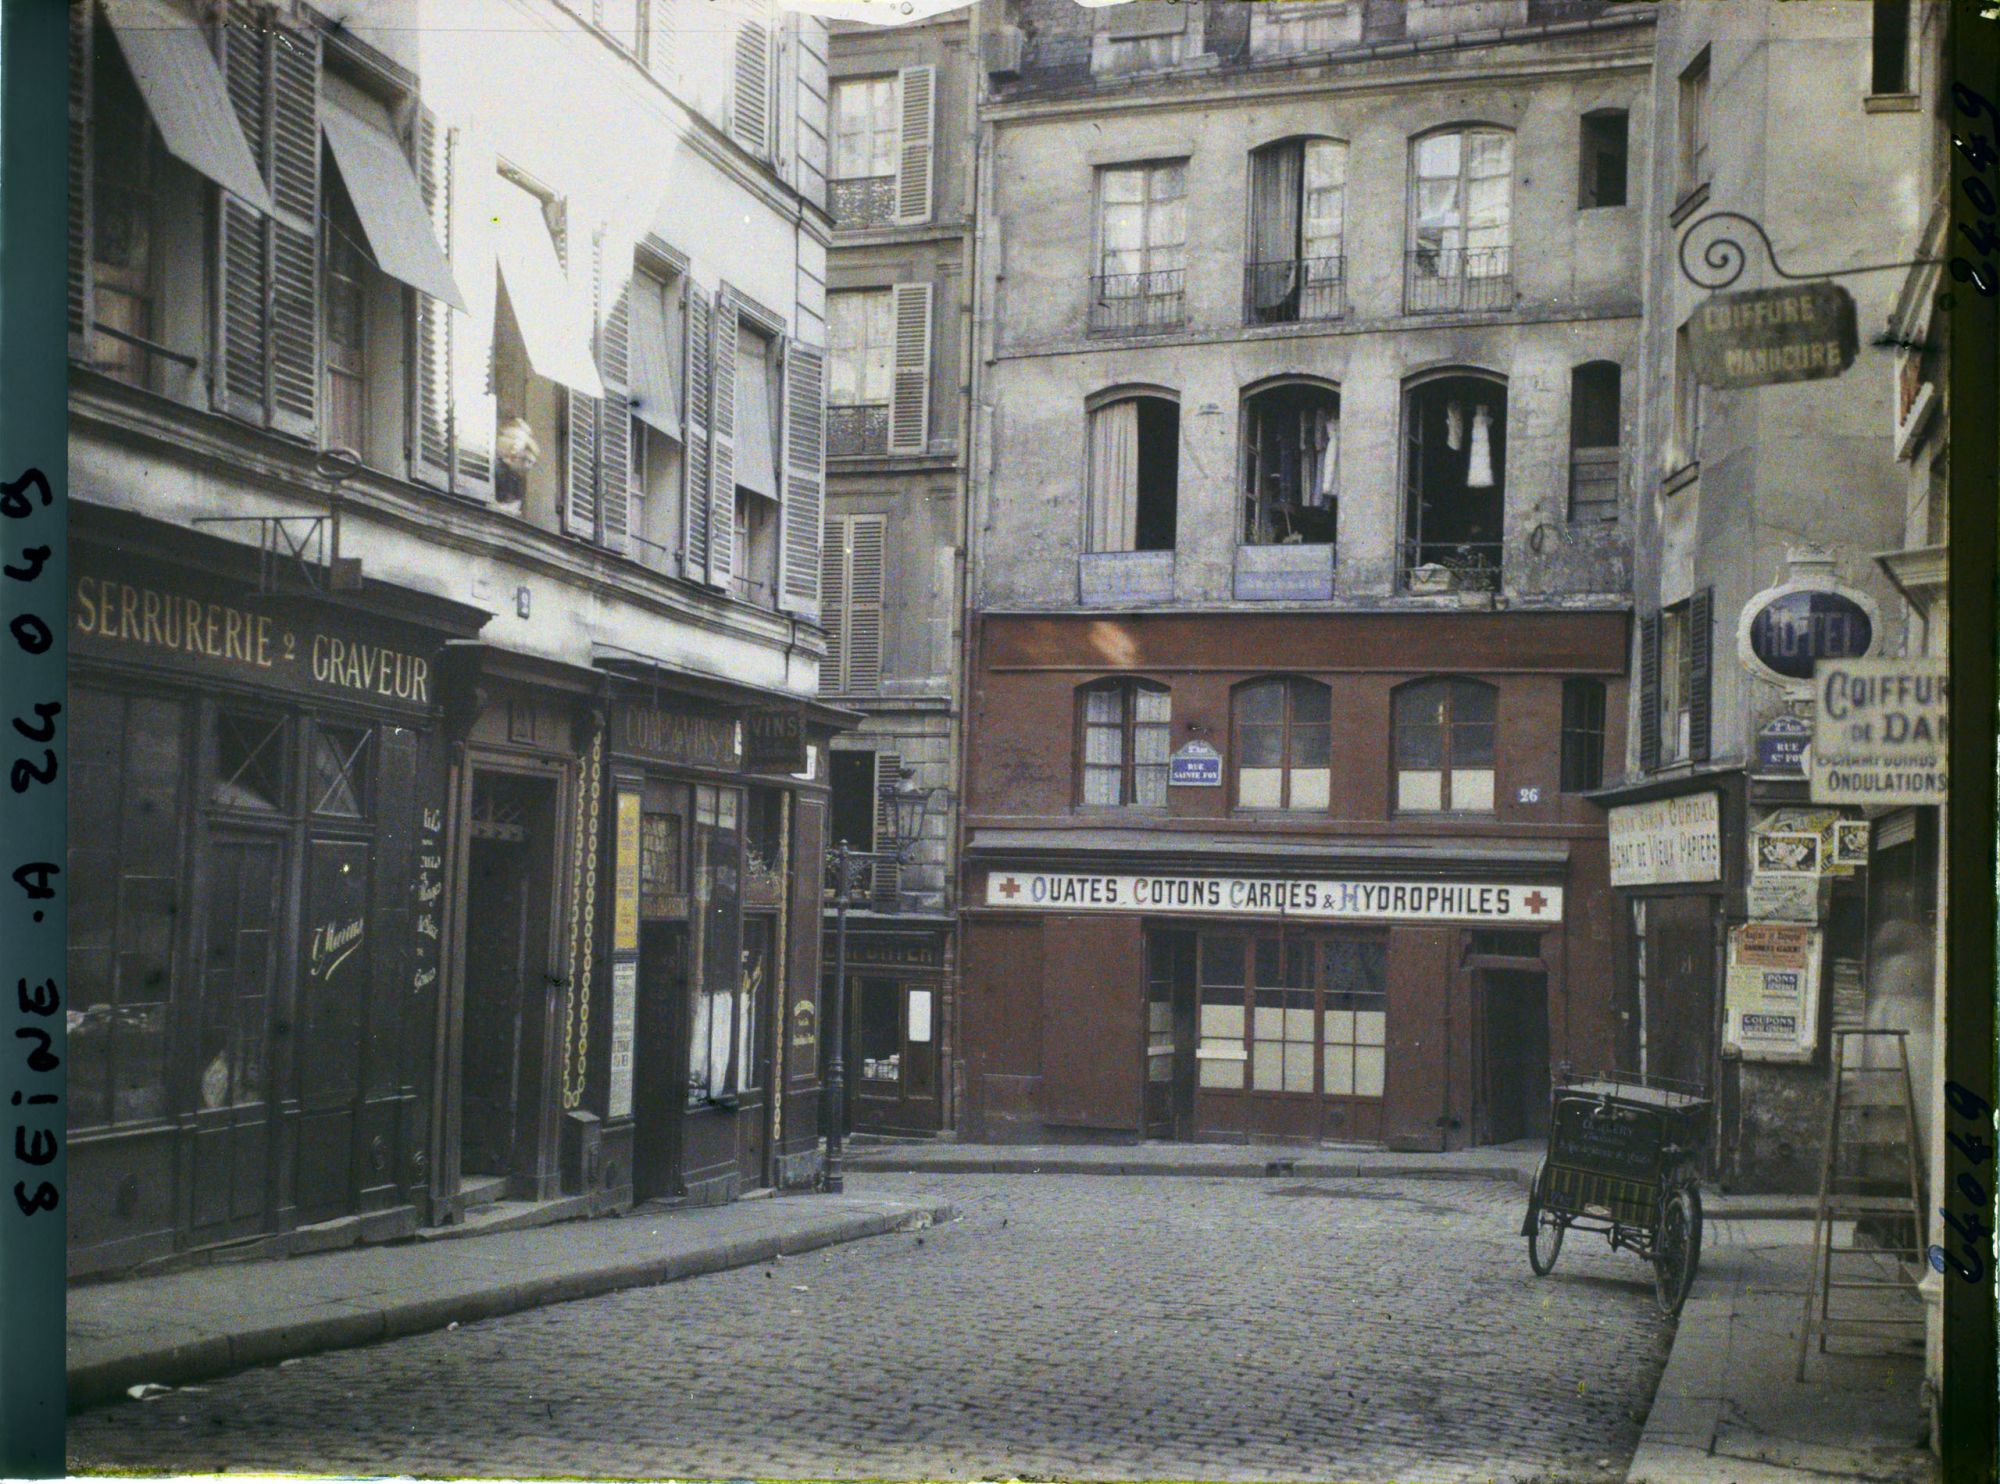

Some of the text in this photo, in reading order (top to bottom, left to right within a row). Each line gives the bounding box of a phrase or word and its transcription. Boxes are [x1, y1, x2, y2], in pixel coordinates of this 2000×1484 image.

[1703, 295, 1815, 331] COIFFURE
[77, 575, 272, 667] SERRURERIE
[312, 634, 429, 703] GRAVEUR
[1776, 743, 1799, 752] RUE
[1174, 771, 1217, 779] SAINTE FOY
[1187, 763, 1204, 771] RUE
[1828, 769, 1948, 792] ONDULATIONS
[1520, 788, 1538, 803] 26
[1647, 833, 1674, 867] VIEUX
[1679, 831, 1718, 864] PAPIERS
[1031, 876, 1511, 914] OUATES COTONS CARDES & HYDROPHILES
